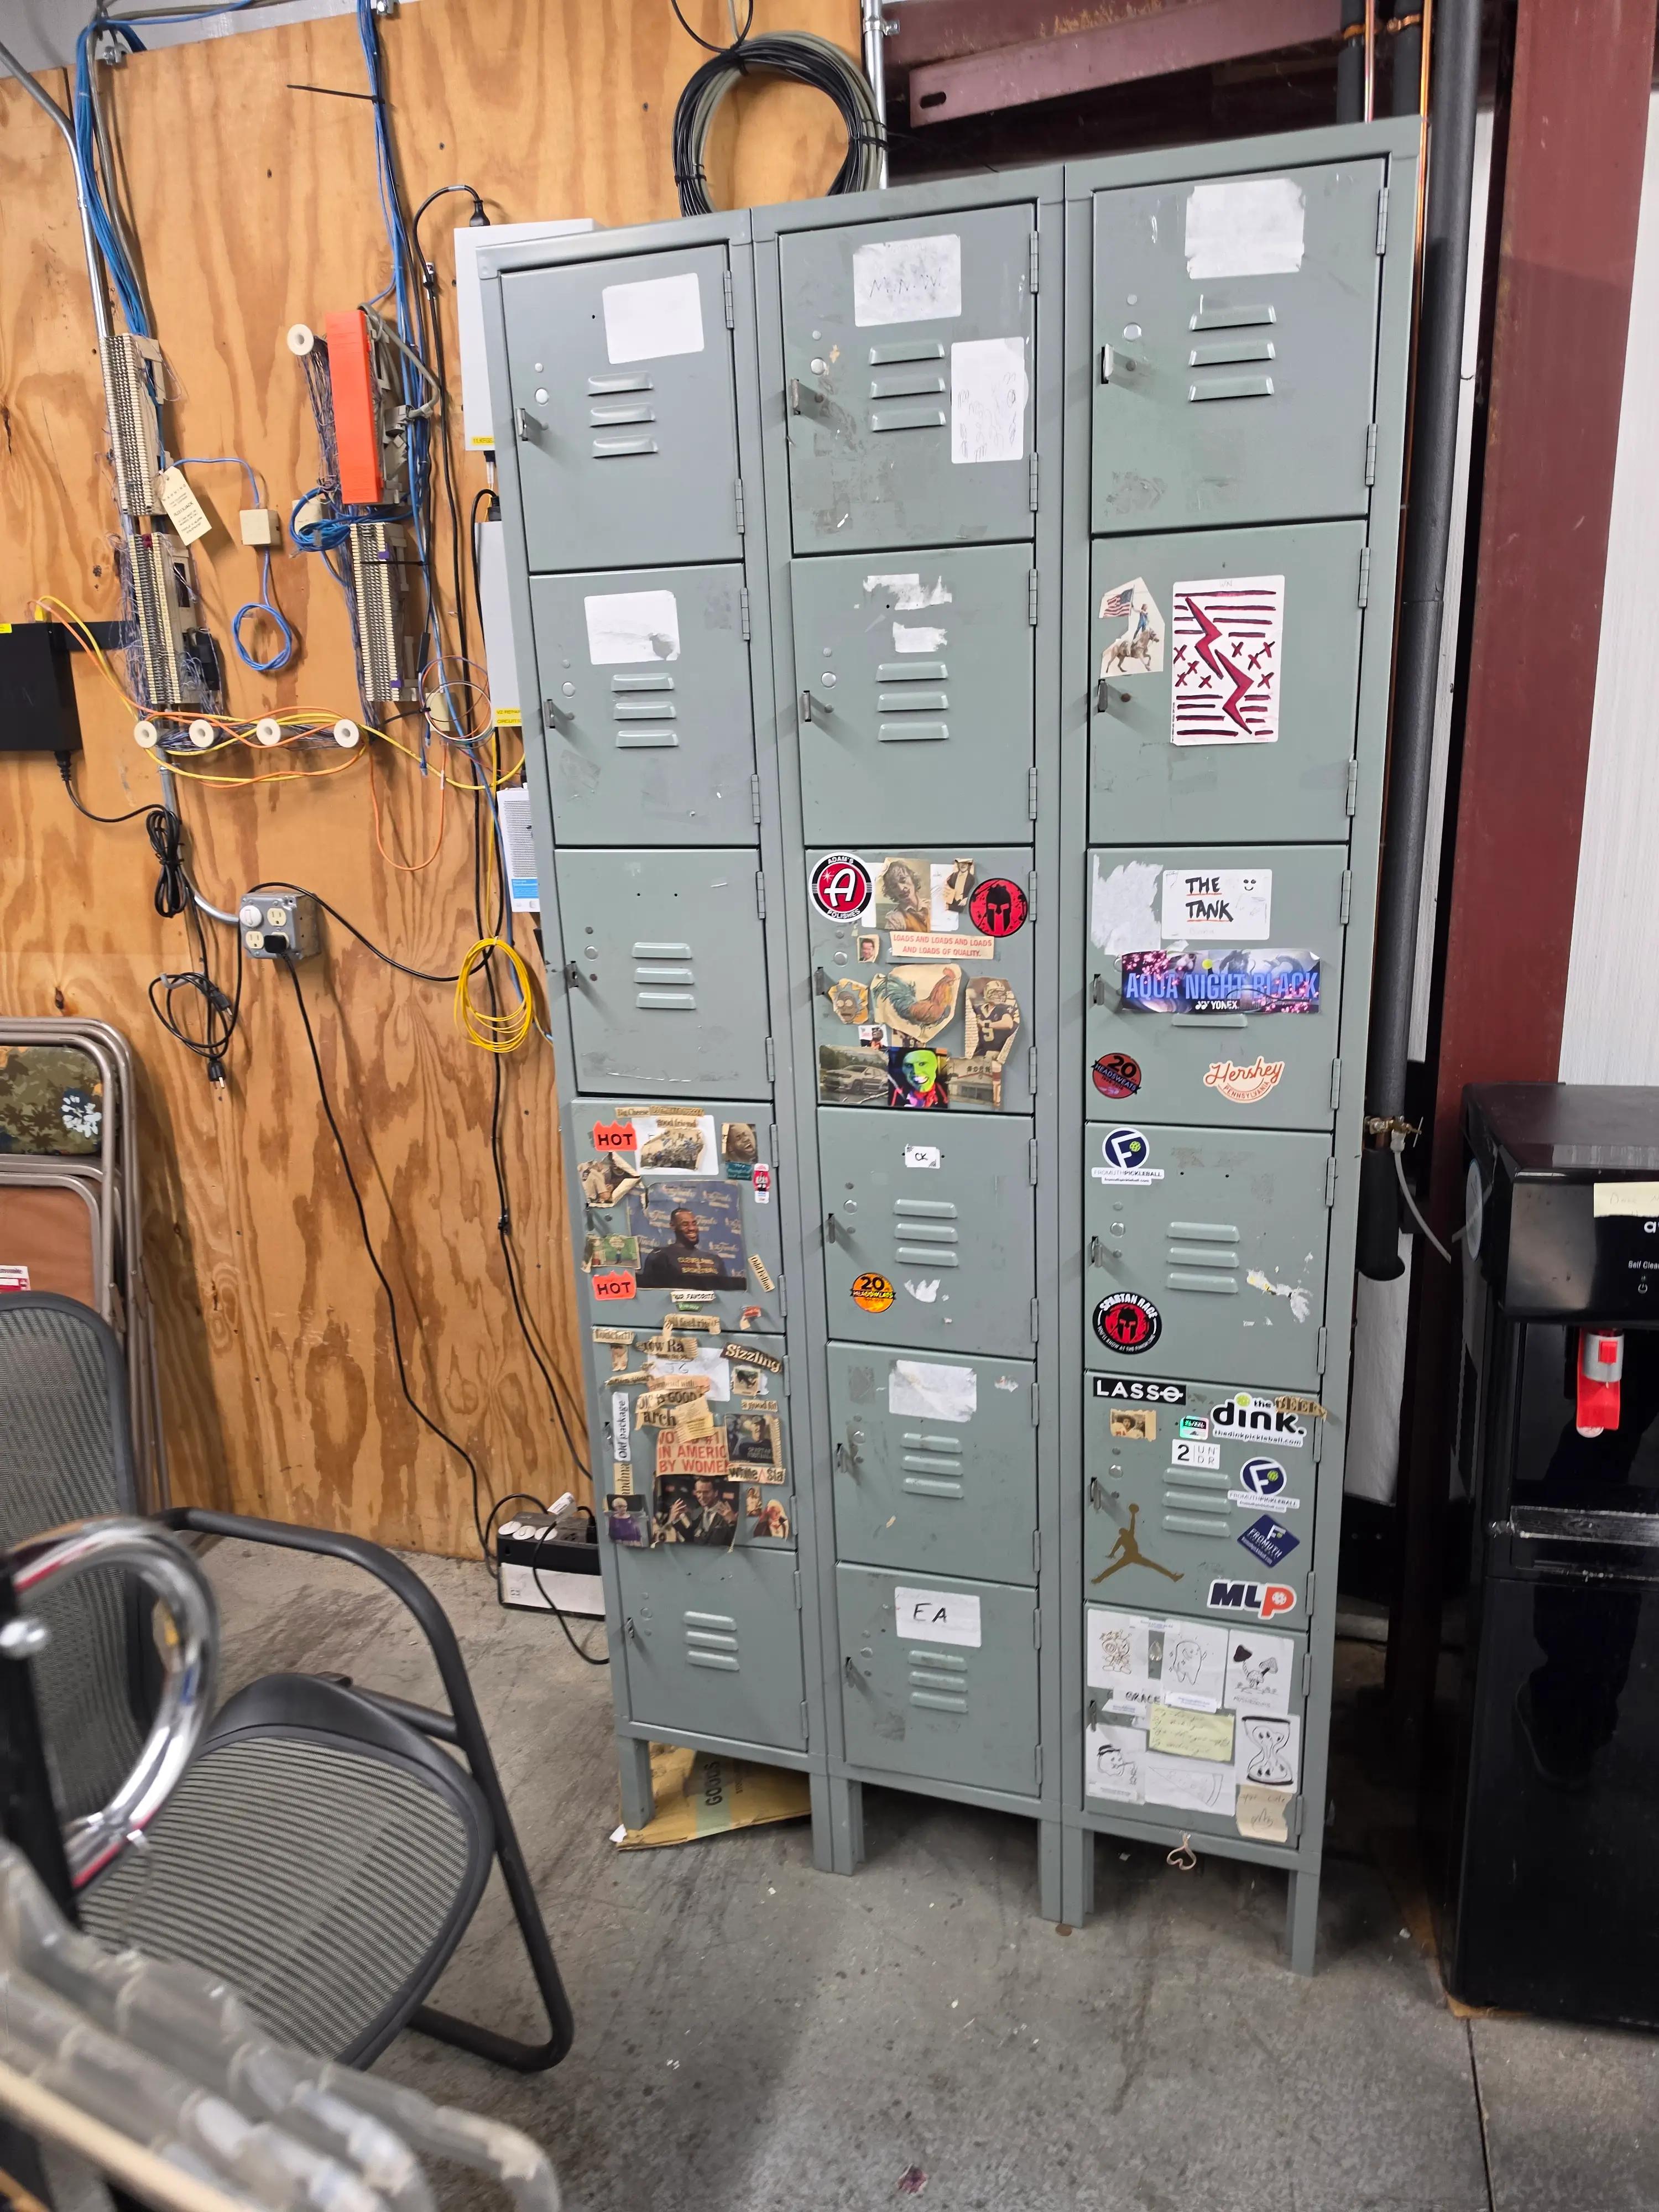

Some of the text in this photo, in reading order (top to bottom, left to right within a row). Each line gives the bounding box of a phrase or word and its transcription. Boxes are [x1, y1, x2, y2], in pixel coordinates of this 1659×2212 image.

[828, 856, 854, 864] ADAM'S
[1185, 877, 1221, 894] THE
[827, 909, 861, 919] POLISHES
[1185, 900, 1234, 922] TANK
[893, 934, 914, 942] LOADS
[1126, 972, 1318, 999] AQUA NIGHT BLACK
[1211, 1000, 1239, 1010] YONEX
[1107, 1055, 1137, 1078] 20
[1206, 1058, 1282, 1084] Hershey
[1095, 1064, 1137, 1091] HEADSWEATS
[1223, 1081, 1270, 1099] PENNSYLVANIA
[598, 1134, 633, 1146] HOT
[1644, 1220, 1659, 1234] a
[1628, 1260, 1641, 1269] Self
[597, 1281, 630, 1295] HOT
[860, 1276, 885, 1291] 20
[1099, 1293, 1158, 1319] SPARTAN RACE
[1106, 1338, 1119, 1349] KNOW
[725, 1344, 781, 1373] Sizzling
[1097, 1380, 1183, 1402] LASSO
[1254, 1399, 1271, 1408] the
[616, 1400, 628, 1459] Old package
[1214, 1430, 1302, 1446] thedinkpickleball.com
[658, 1444, 727, 1459] IN AMERIC
[1177, 1444, 1190, 1462] 2
[660, 1459, 676, 1473] BY
[1247, 1527, 1282, 1558] FROMUTH
[1210, 1583, 1294, 1616] MLP
[1126, 1691, 1160, 1705] GRACE
[703, 1761, 723, 1806] GOODS
